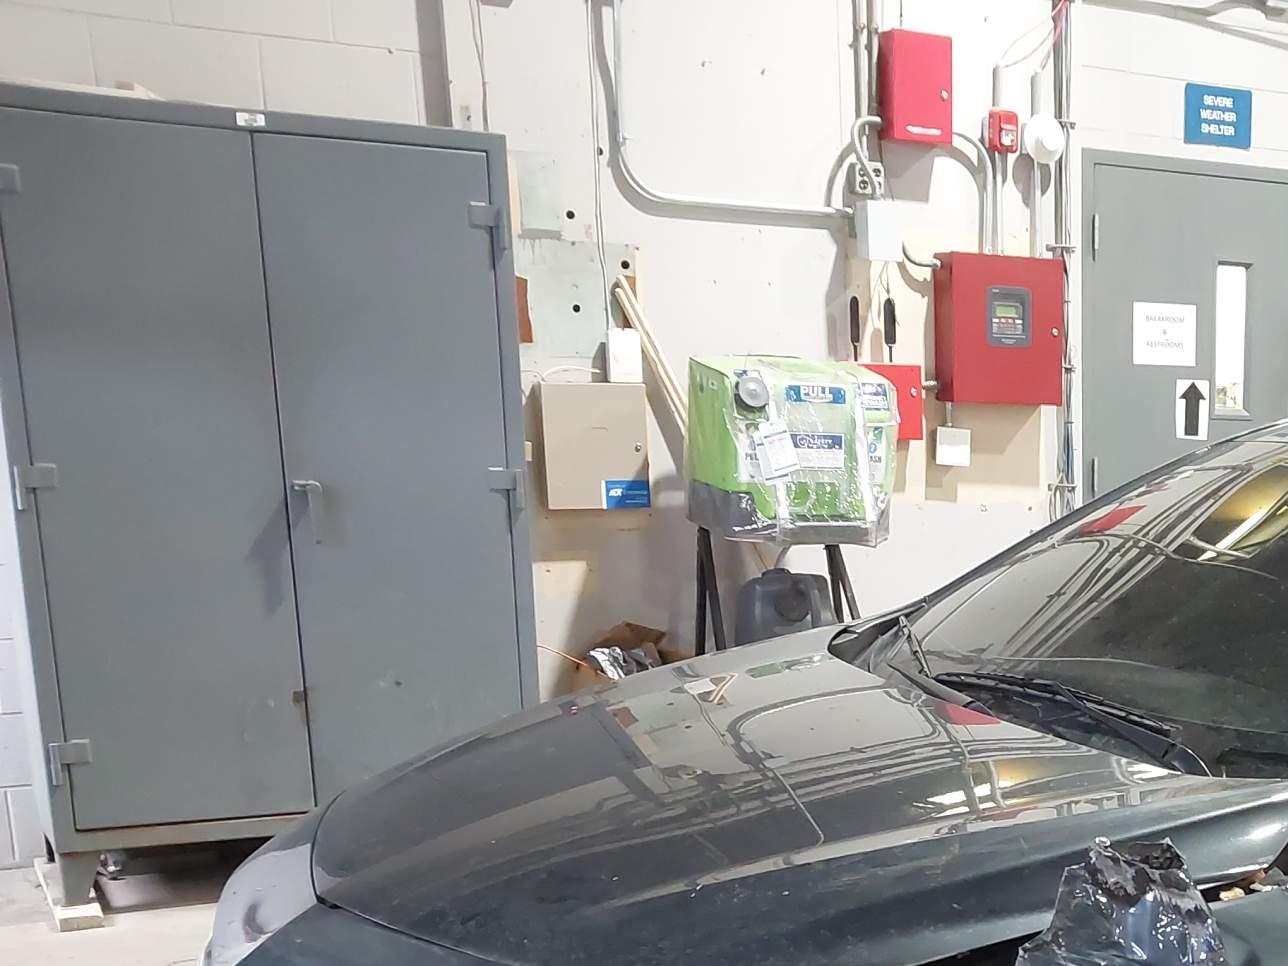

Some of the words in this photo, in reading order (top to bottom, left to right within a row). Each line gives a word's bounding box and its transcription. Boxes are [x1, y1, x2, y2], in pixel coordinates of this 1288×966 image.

[1203, 94, 1234, 108] SEVERE
[1199, 108, 1237, 122] WEATHER
[1200, 122, 1235, 137] SHELTER
[800, 385, 833, 398] PULL
